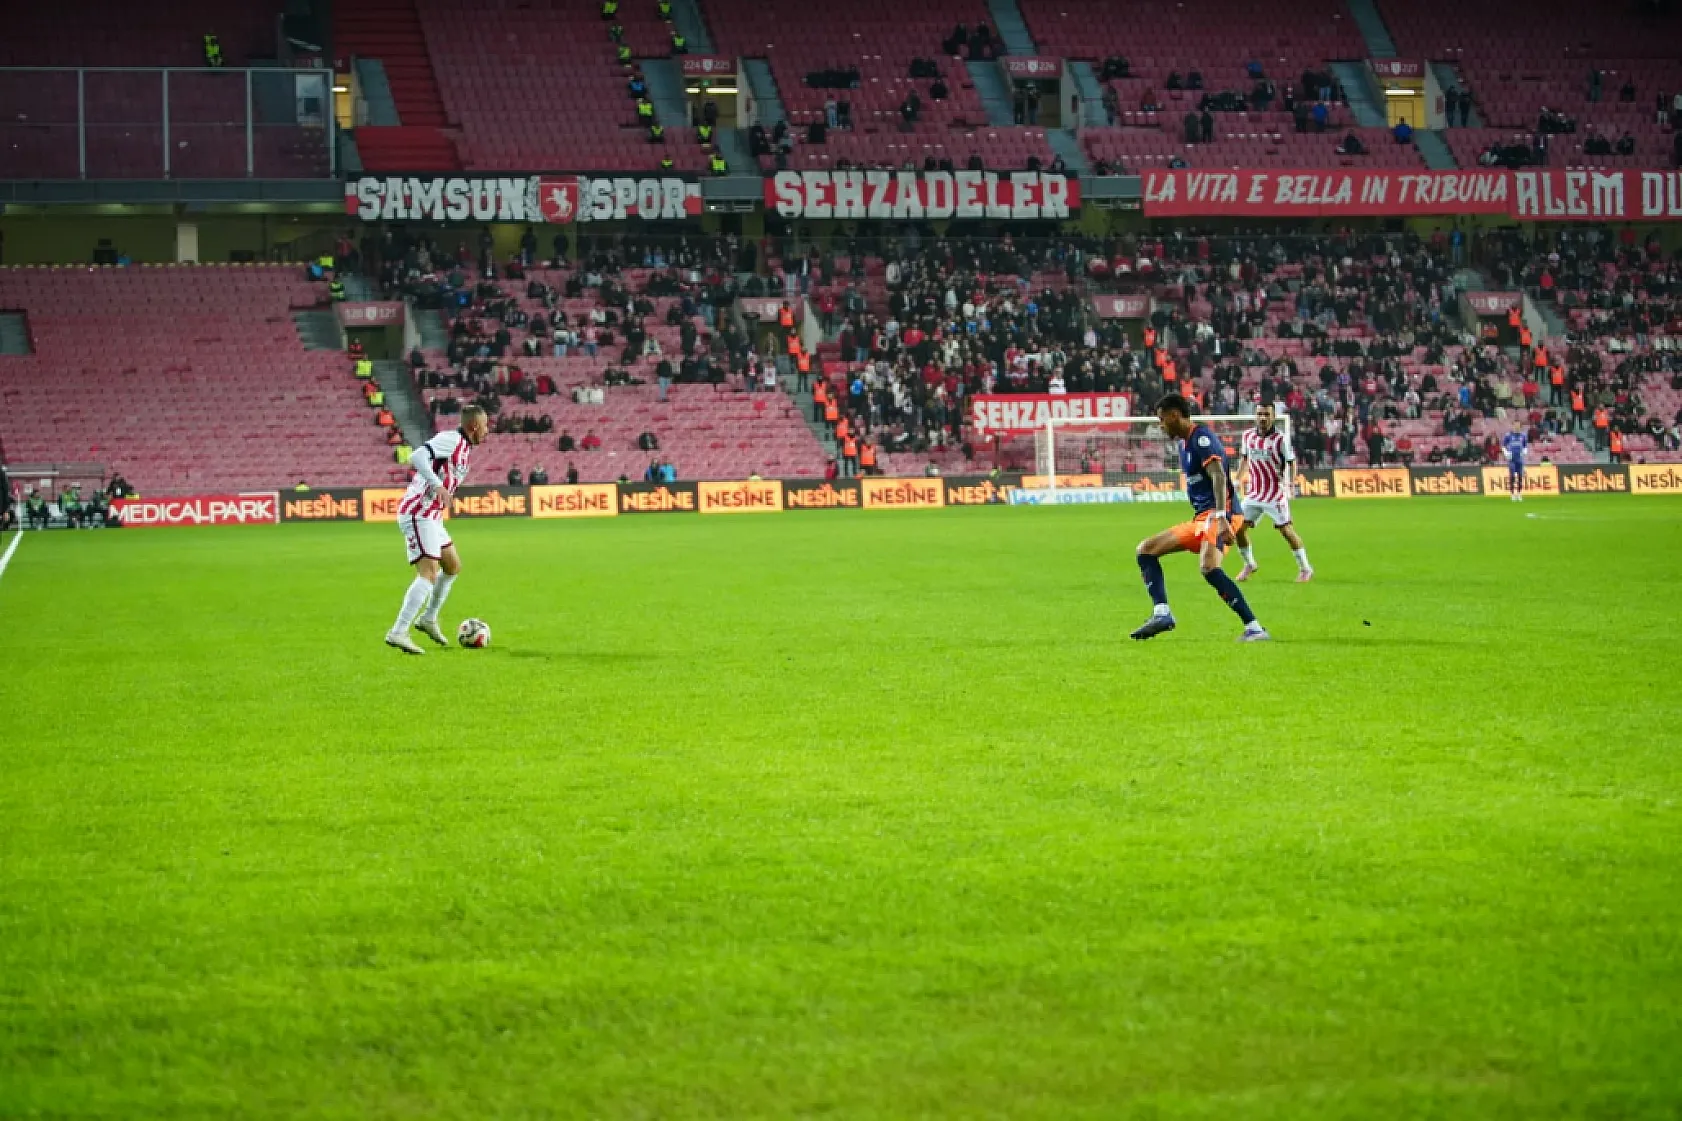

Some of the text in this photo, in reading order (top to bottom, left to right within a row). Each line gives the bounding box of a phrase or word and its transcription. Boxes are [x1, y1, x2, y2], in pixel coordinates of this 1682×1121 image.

[357, 177, 687, 220] SAMSUN SPOR
[1145, 173, 1508, 205] LA VITA E BELLA IN TRIBUNA
